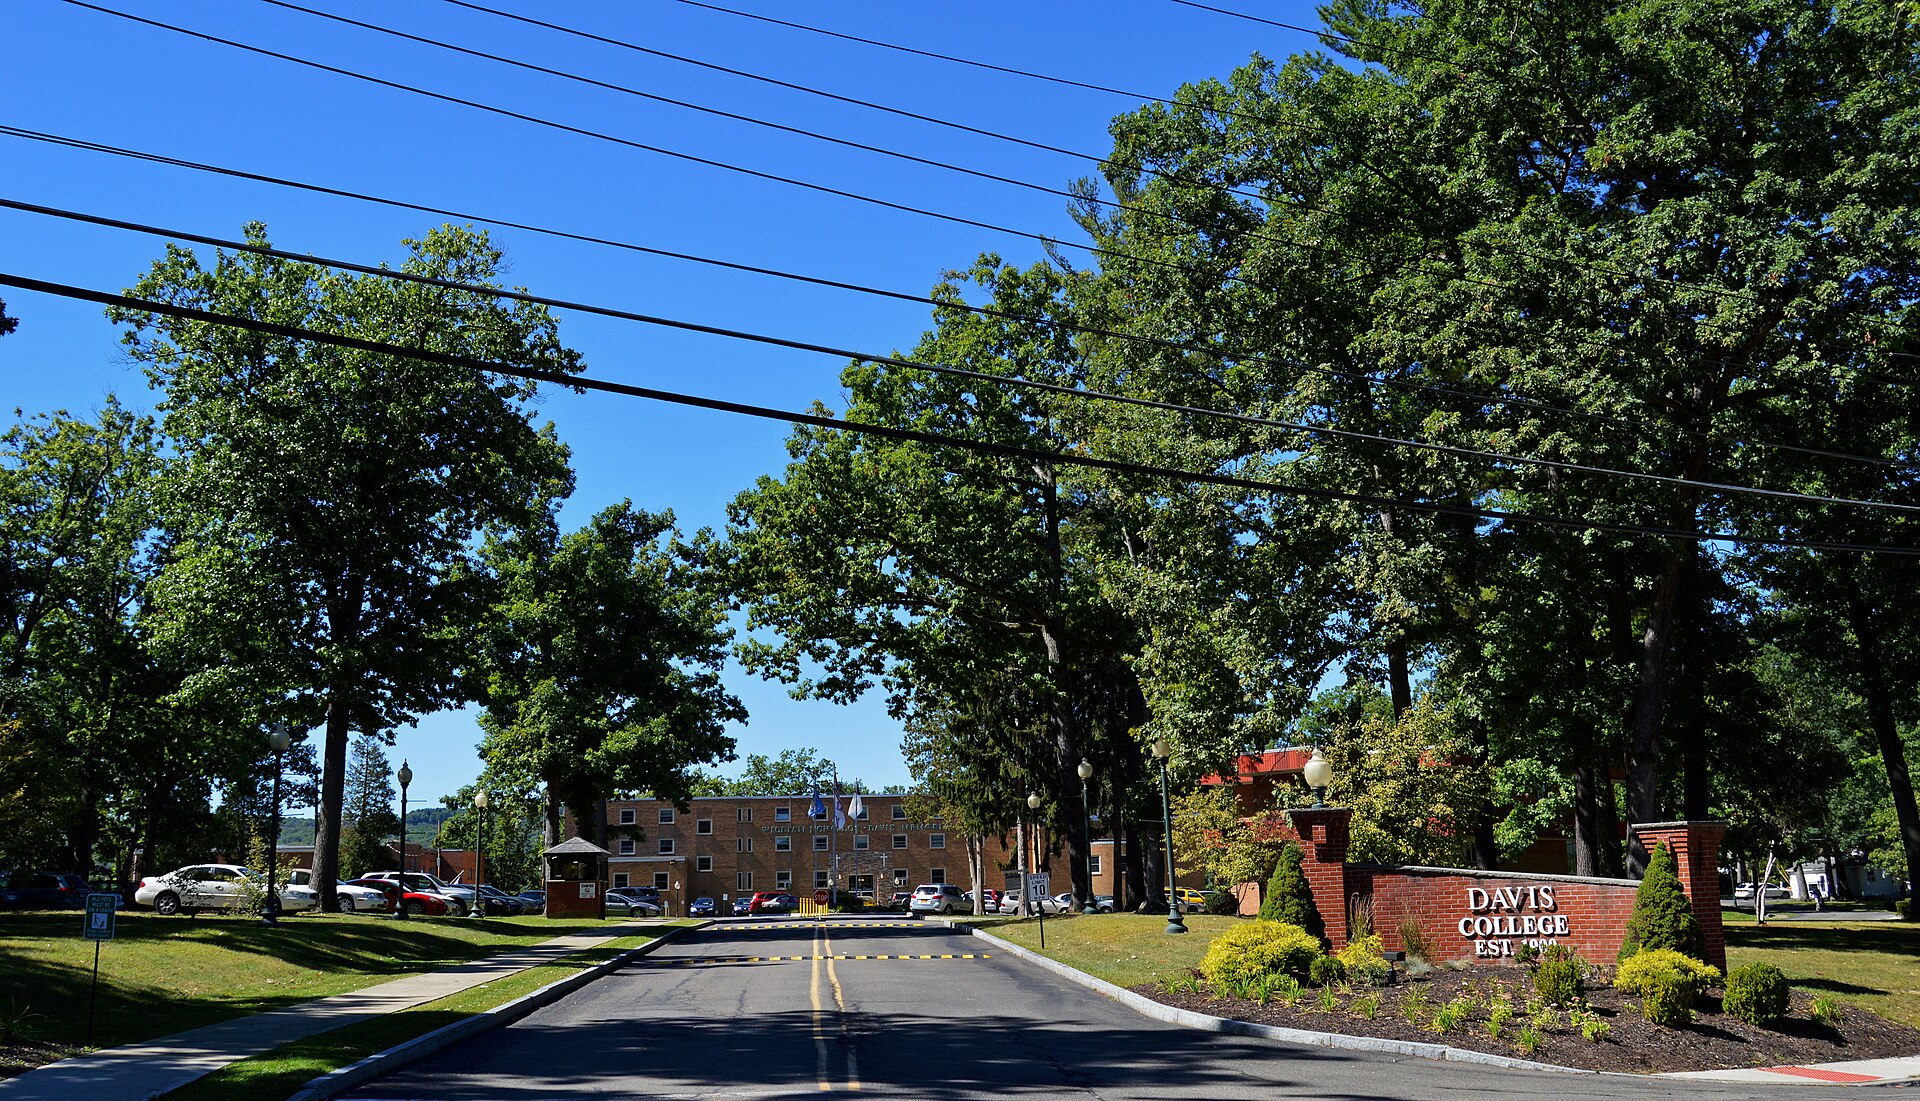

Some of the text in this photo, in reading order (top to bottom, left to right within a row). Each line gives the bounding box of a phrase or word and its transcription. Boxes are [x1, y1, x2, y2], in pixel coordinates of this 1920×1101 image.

[867, 824, 895, 832] DAVIS
[1033, 885, 1046, 896] 10
[1466, 885, 1554, 911] DAVIS
[1458, 914, 1570, 937] COLLEGE
[1473, 939, 1515, 956] EST.
